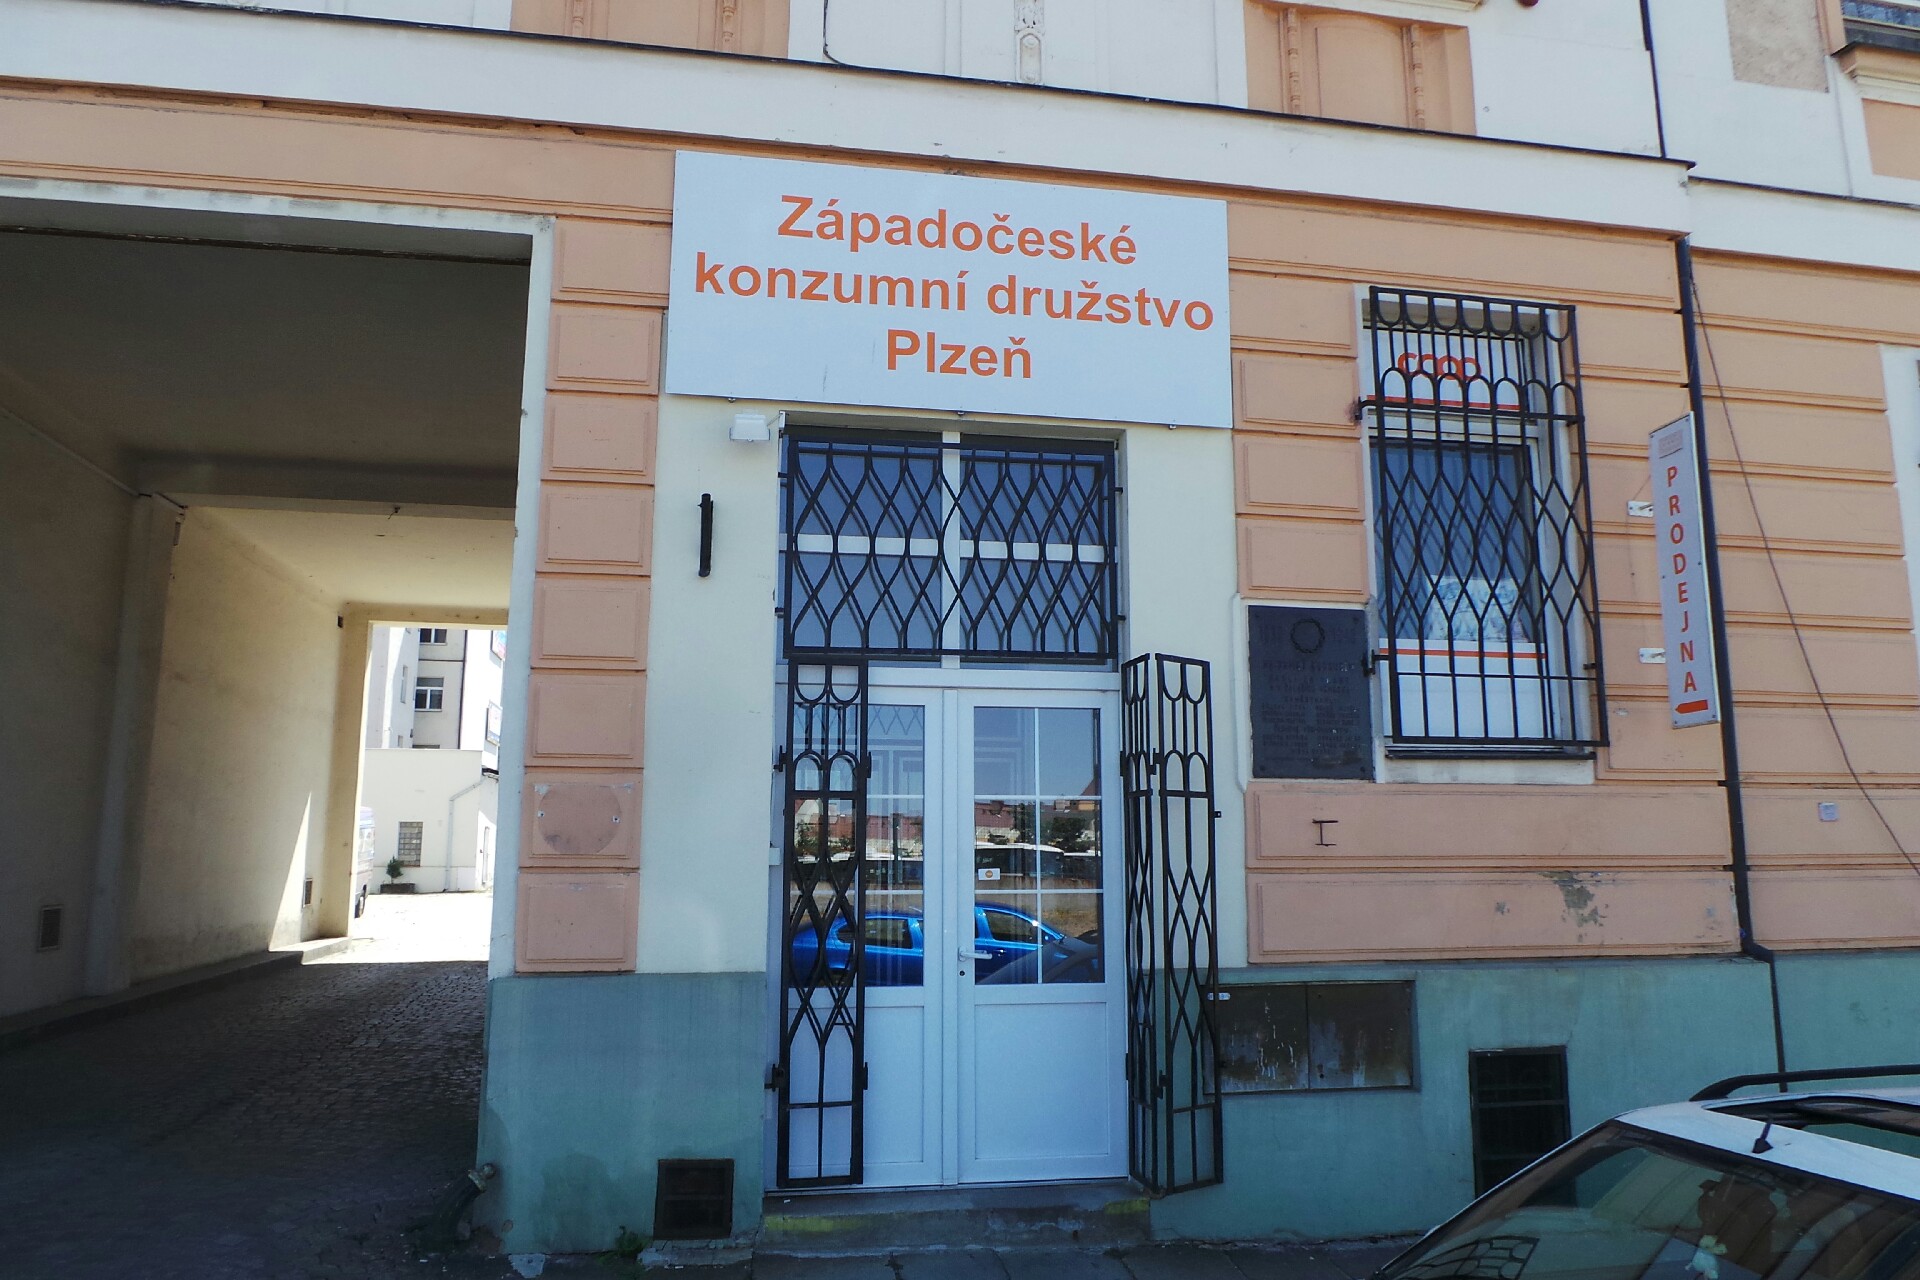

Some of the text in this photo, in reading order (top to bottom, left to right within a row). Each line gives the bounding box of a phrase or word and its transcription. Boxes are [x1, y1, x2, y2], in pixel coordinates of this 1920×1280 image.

[778, 195, 1137, 265] Západočeské
[696, 252, 1213, 331] konzumní družstvo
[887, 329, 1031, 378] Plzeň
[1666, 465, 1697, 693] PRODEJNA
